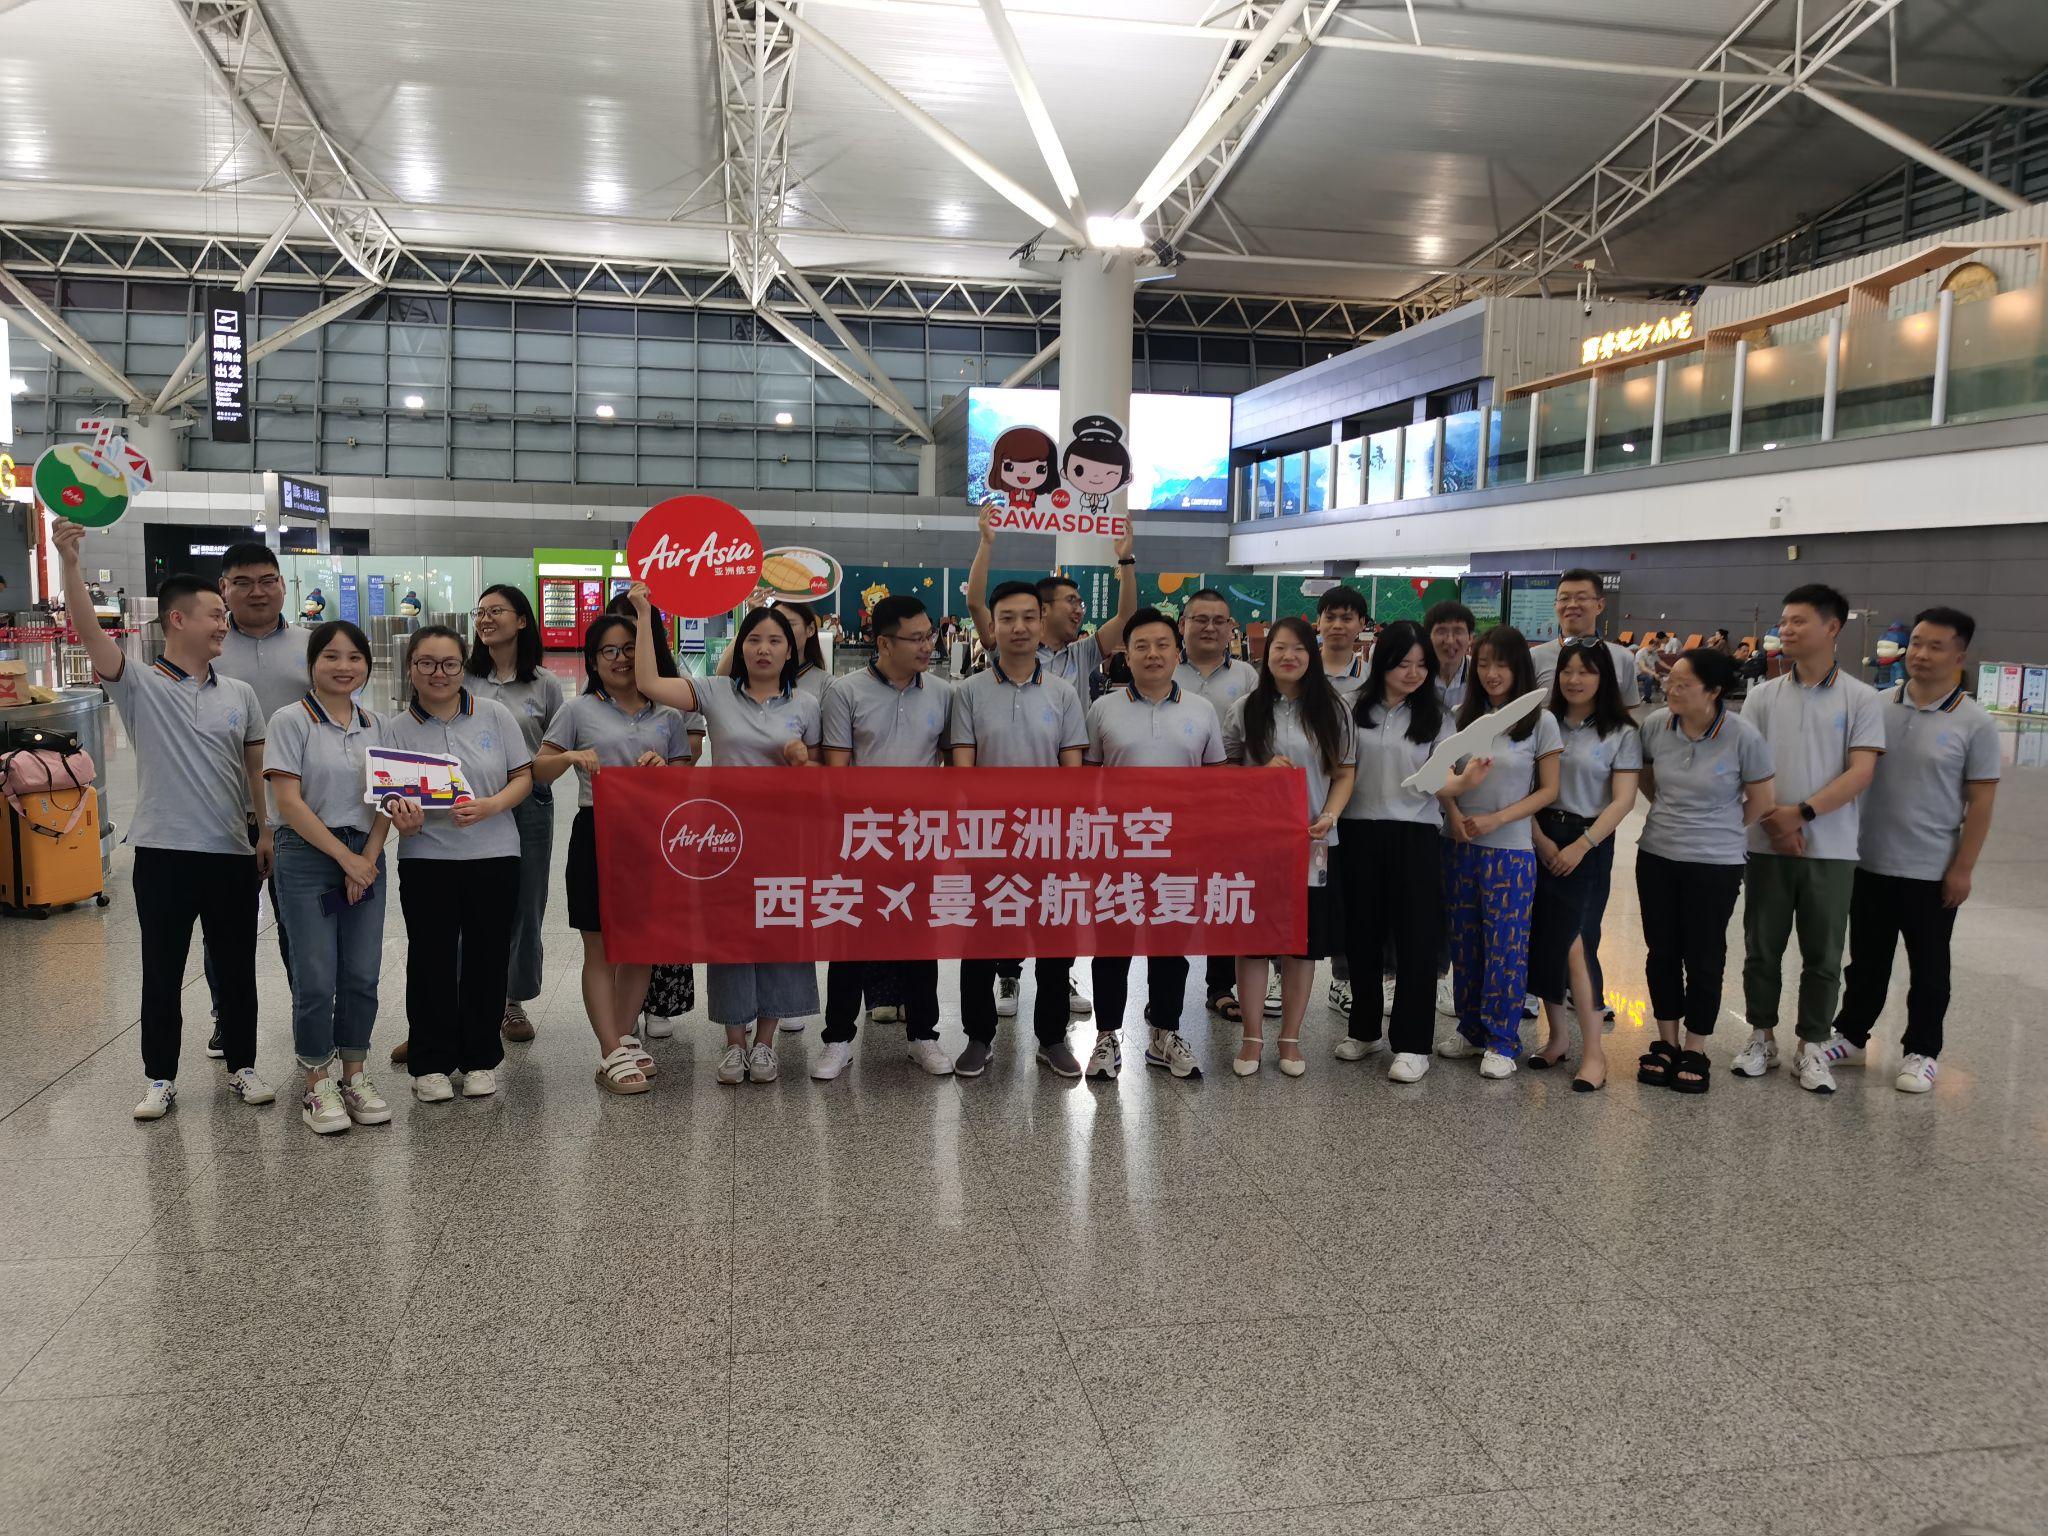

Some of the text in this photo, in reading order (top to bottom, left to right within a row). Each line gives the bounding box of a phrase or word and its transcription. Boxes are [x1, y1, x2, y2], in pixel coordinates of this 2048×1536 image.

[213, 334, 242, 351] 国际
[213, 351, 242, 363] 港澳台
[214, 363, 242, 380] 出发
[989, 508, 1127, 536] SAWASDEE
[714, 565, 757, 576] 亚洲航空
[839, 806, 1173, 861] 庆祝亚洲航空
